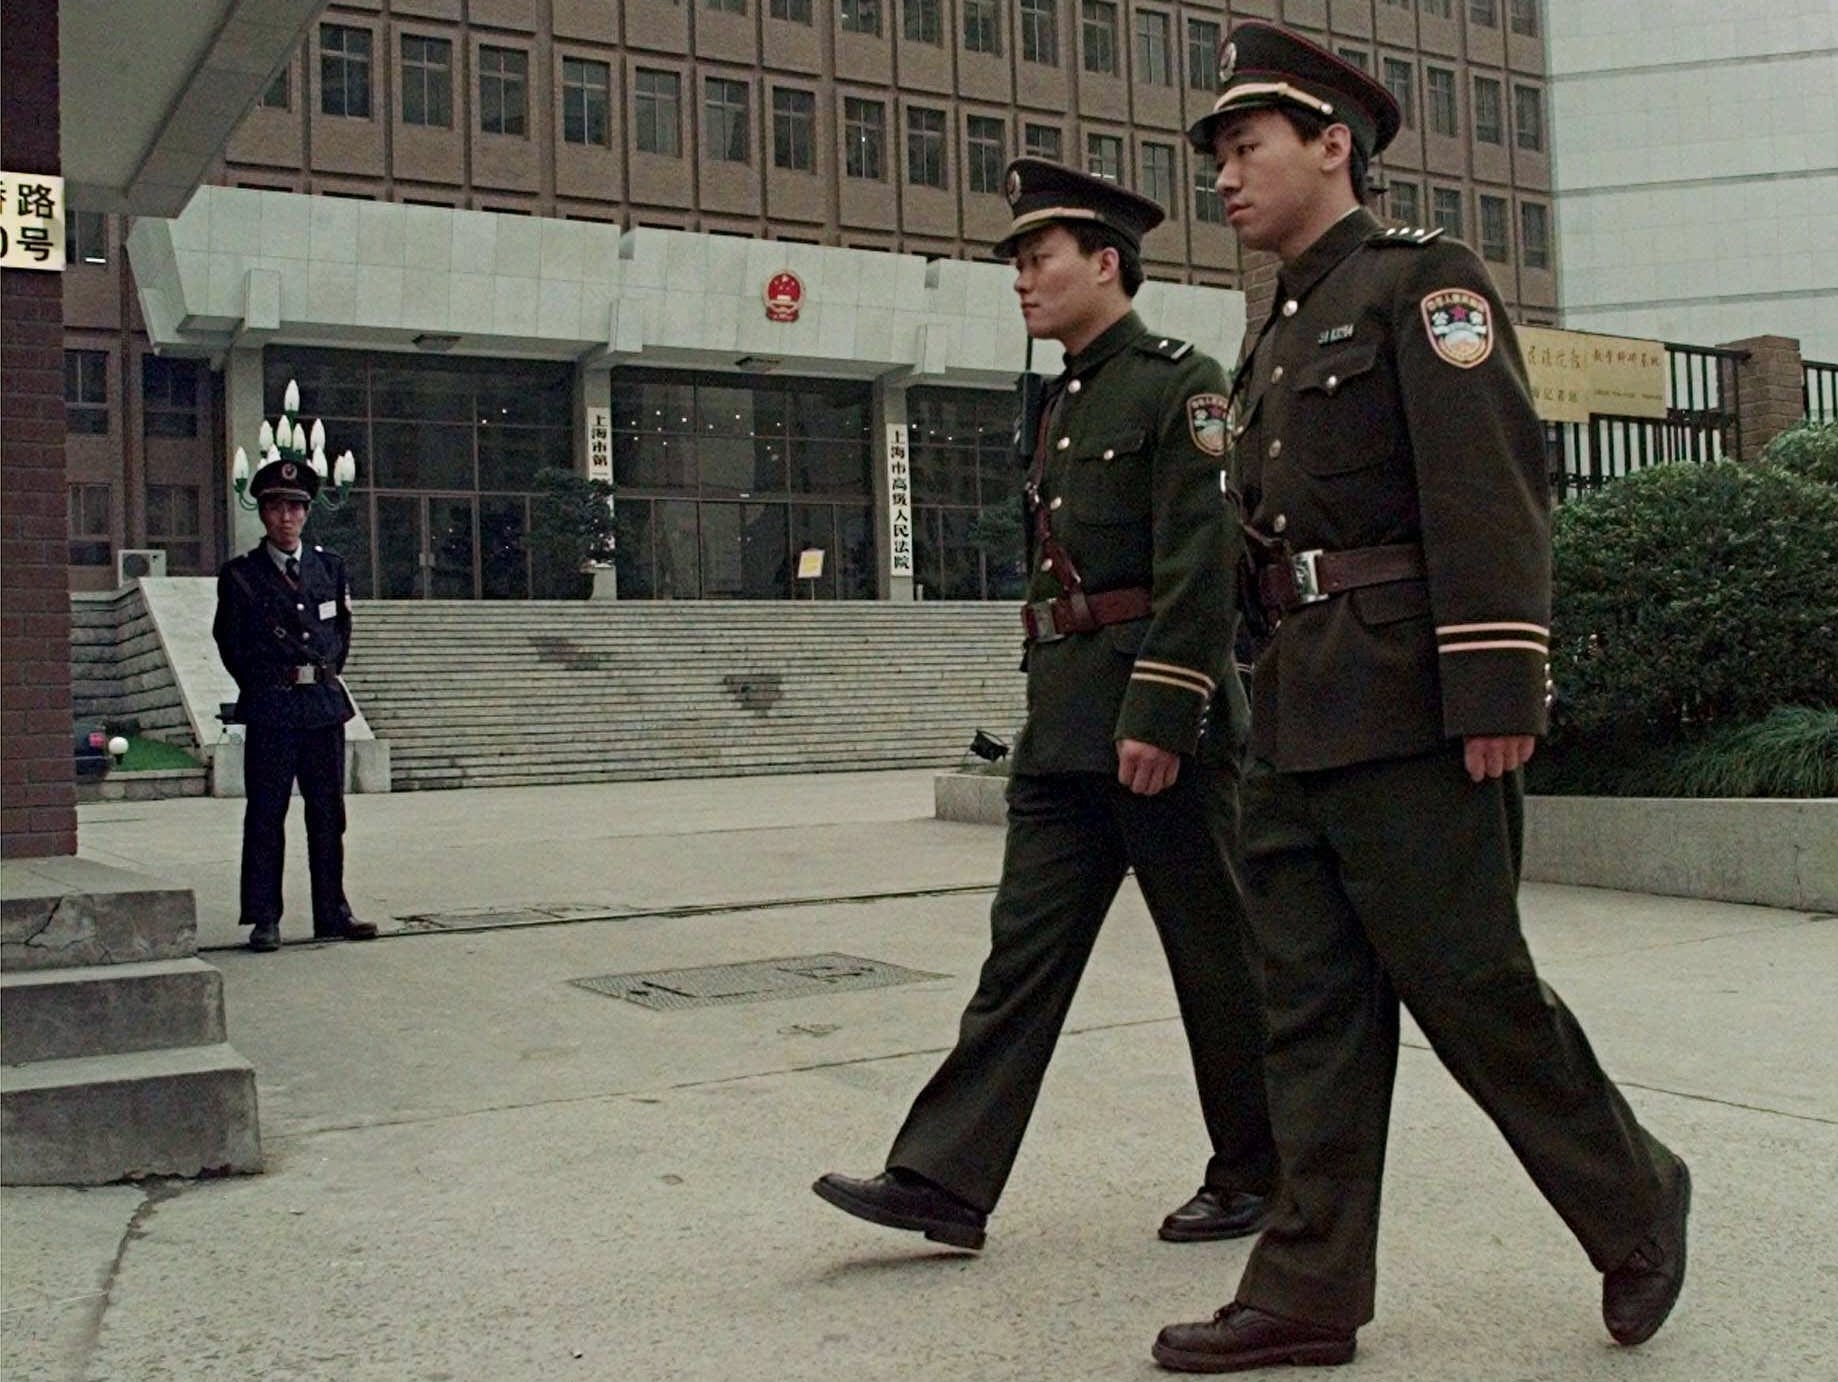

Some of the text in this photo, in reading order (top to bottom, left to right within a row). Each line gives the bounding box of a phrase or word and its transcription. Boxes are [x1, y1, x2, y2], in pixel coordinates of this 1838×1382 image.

[0, 181, 55, 219] 路
[890, 429, 910, 570] 上海市高级人民法院
